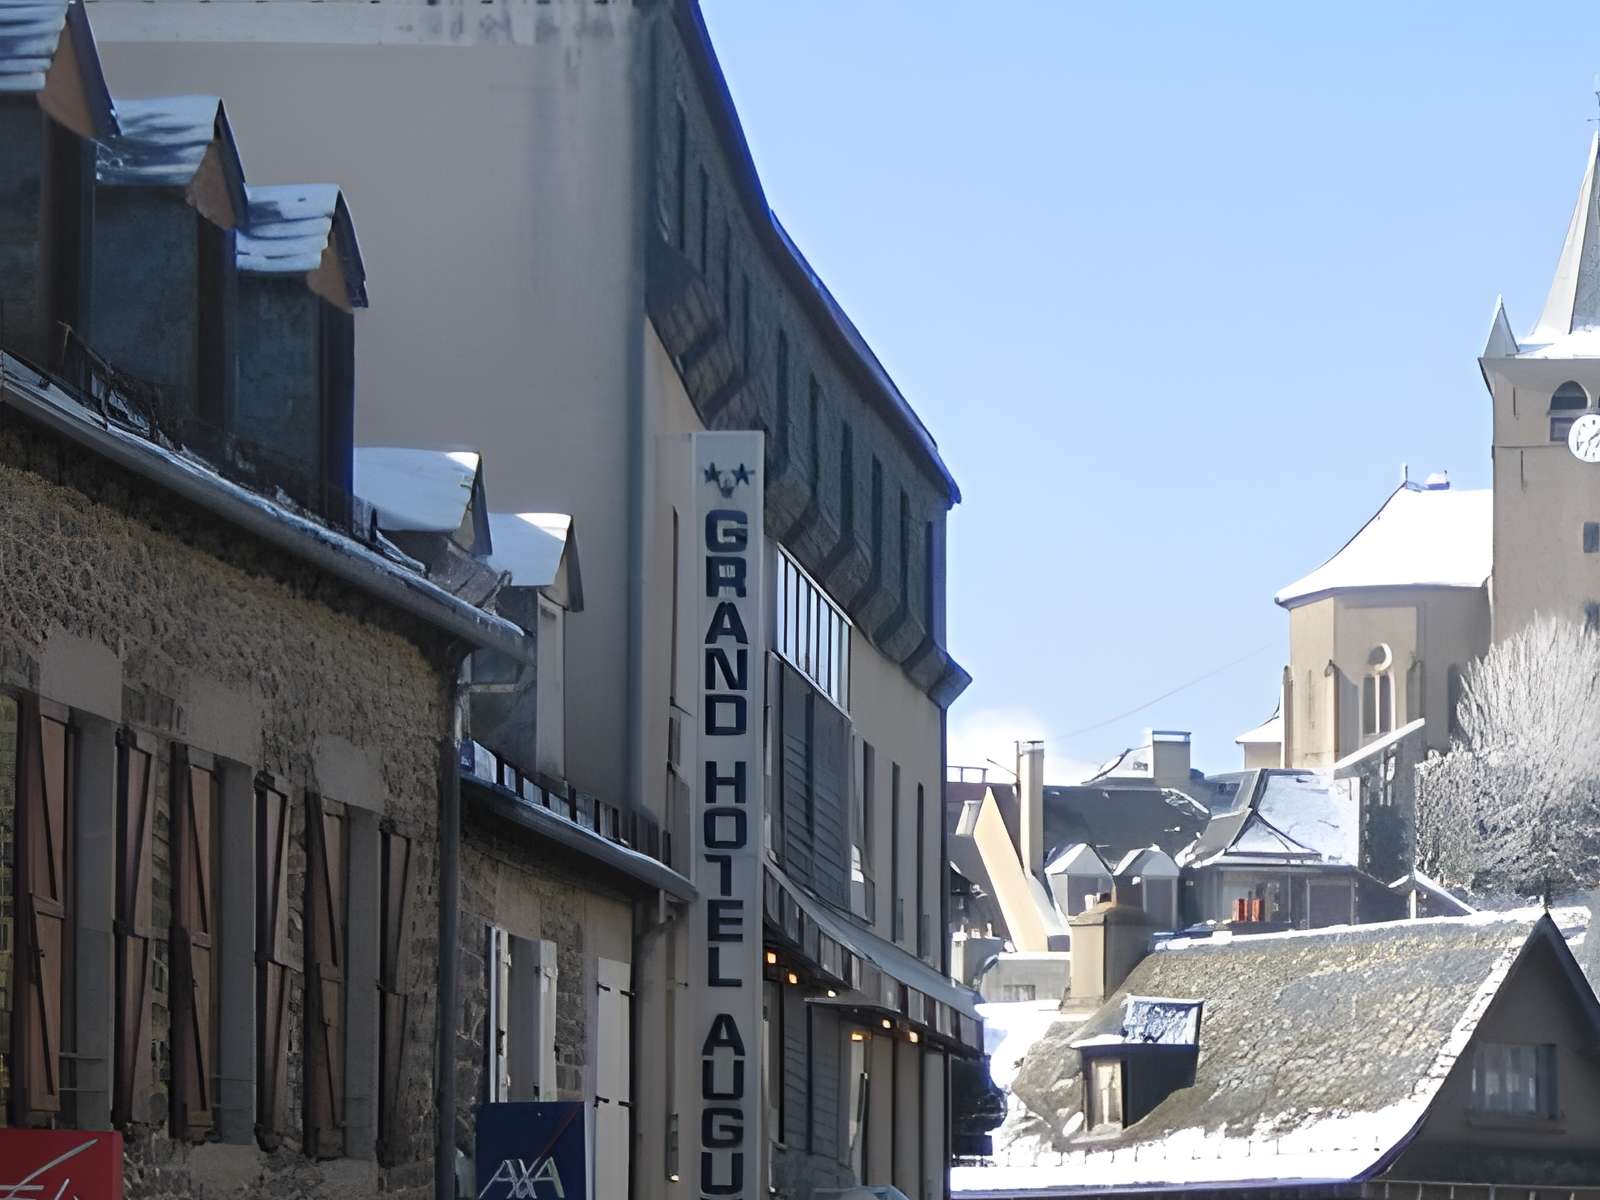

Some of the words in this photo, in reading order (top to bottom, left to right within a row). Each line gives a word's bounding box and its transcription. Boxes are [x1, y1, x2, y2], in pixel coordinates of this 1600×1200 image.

[704, 509, 749, 737] GRAND
[703, 760, 748, 988] HOTEL
[479, 1156, 565, 1199] AXA
